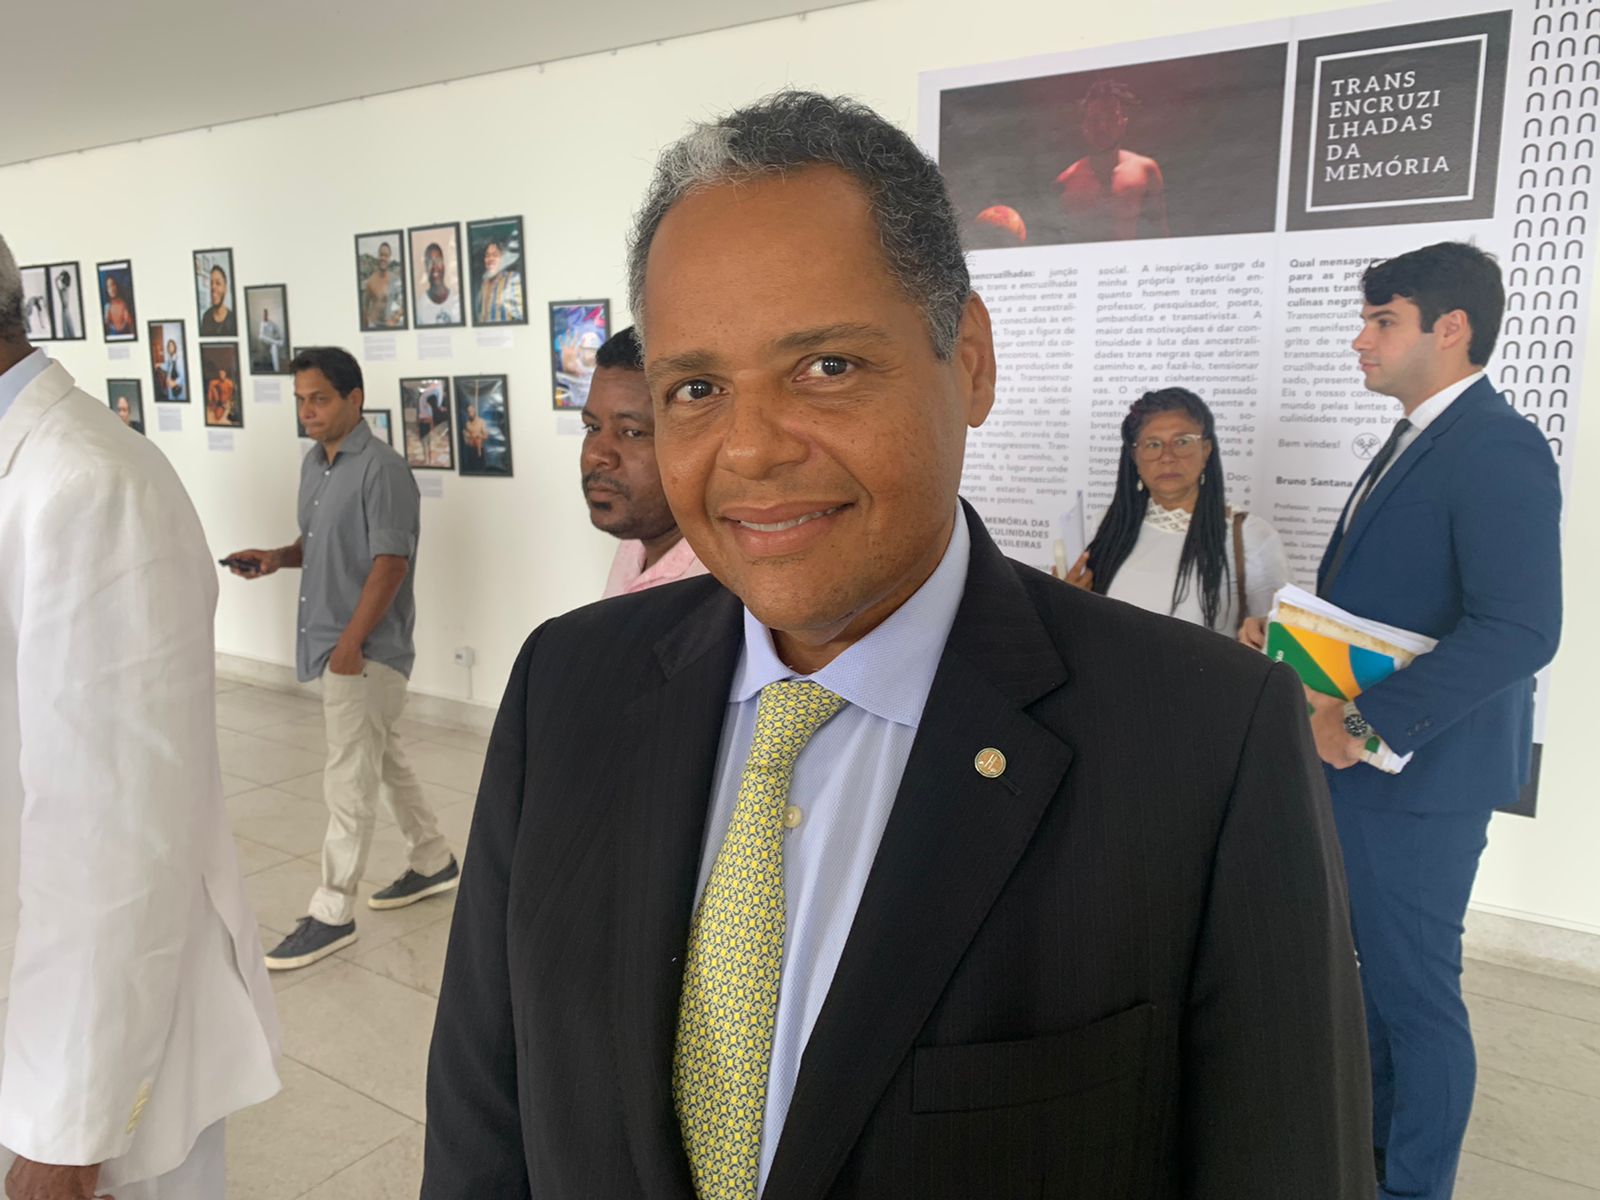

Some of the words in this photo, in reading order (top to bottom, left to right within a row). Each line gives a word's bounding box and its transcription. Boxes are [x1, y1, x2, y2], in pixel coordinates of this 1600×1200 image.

[1331, 71, 1416, 97] TRANS
[1329, 90, 1441, 119] ENCRUZI
[1328, 113, 1433, 140] LHADAS
[1326, 143, 1361, 161] DA
[1324, 154, 1450, 182] MEMÓRIA
[1142, 265, 1149, 273] A
[1155, 262, 1208, 274] inspiração
[1214, 261, 1245, 272] surge
[1251, 259, 1265, 269] da
[1290, 258, 1315, 268] Qual
[1098, 278, 1128, 287] minha
[1138, 276, 1175, 288] própria
[1186, 274, 1235, 285] trajetória
[1289, 273, 1313, 283] para
[1322, 272, 1334, 280] as
[1097, 291, 1132, 300] quanto
[1142, 289, 1180, 297] homem
[1190, 288, 1217, 296] trans
[1228, 287, 1263, 296] negro,
[1288, 285, 1329, 294] homens
[1153, 300, 1219, 311] pesquisador,
[1287, 298, 1324, 307] culinas
[1096, 313, 1154, 323] umbandista
[1160, 314, 1166, 322] e
[1253, 311, 1262, 319] A
[1287, 310, 1361, 320] Transencruzilh
[1095, 326, 1123, 335] maior
[1126, 325, 1143, 334] das
[1146, 325, 1204, 336] motivações
[1217, 324, 1234, 333] dar
[1095, 338, 1141, 347] tinuidade
[1157, 337, 1176, 346] luta
[1182, 336, 1200, 346] das
[1284, 338, 1310, 348] grito
[1094, 350, 1124, 359] dades
[1128, 351, 1152, 359] trans
[1156, 351, 1190, 360] negras
[1194, 351, 1214, 360] que
[1218, 349, 1260, 358] abriram
[1093, 362, 1135, 371] caminho
[1209, 362, 1259, 370] tensionar
[1282, 363, 1335, 371] cruzilhada
[1339, 363, 1352, 371] de
[1108, 375, 1159, 383] estruturas
[1313, 377, 1360, 386] presente
[1213, 386, 1257, 396] passado
[1281, 388, 1296, 397] Eis
[1092, 399, 1114, 408] para
[1281, 401, 1315, 410] mundo
[1321, 402, 1349, 412] pelas
[1355, 402, 1387, 411] lentes
[1280, 415, 1337, 424] culinidades
[1340, 416, 1380, 426] negras
[1278, 439, 1299, 448] Bem
[1304, 440, 1340, 449] vindes!
[1276, 476, 1307, 485] Bruno
[1310, 477, 1353, 488] Santana
[985, 516, 1028, 526] MEMÓRIA
[1031, 519, 1050, 528] DAS
[989, 528, 1049, 539] CULINIDADES
